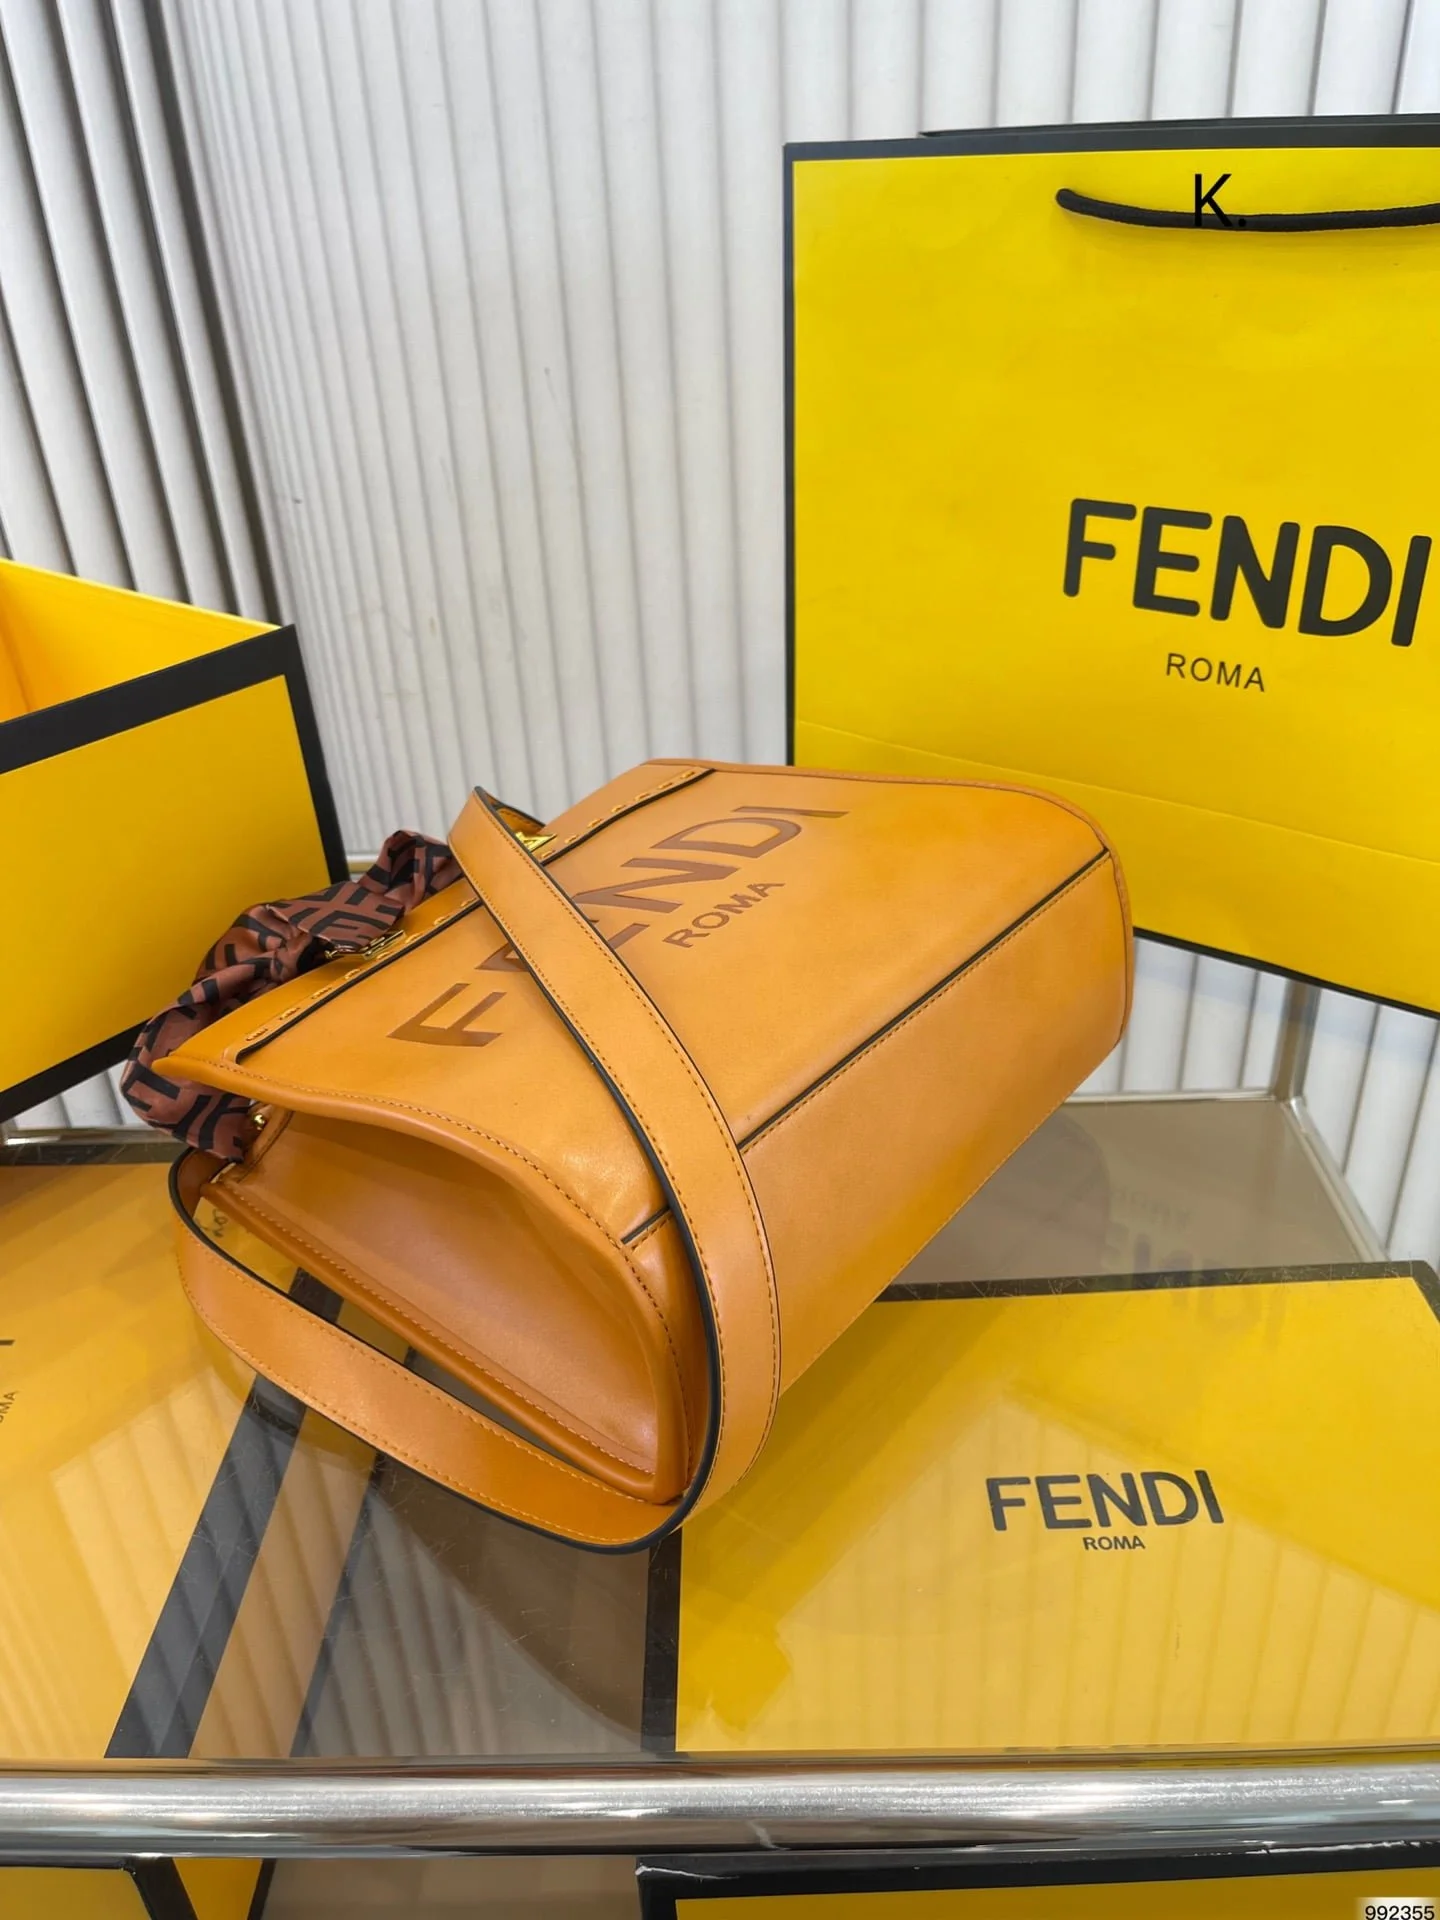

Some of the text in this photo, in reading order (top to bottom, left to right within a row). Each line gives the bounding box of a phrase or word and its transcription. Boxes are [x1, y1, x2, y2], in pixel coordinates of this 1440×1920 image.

[1063, 498, 1432, 647] FENDI
[1165, 653, 1266, 692] ROMA
[662, 882, 785, 948] ROMA
[986, 1469, 1225, 1531] FENDI
[1082, 1535, 1146, 1550] ROMA
